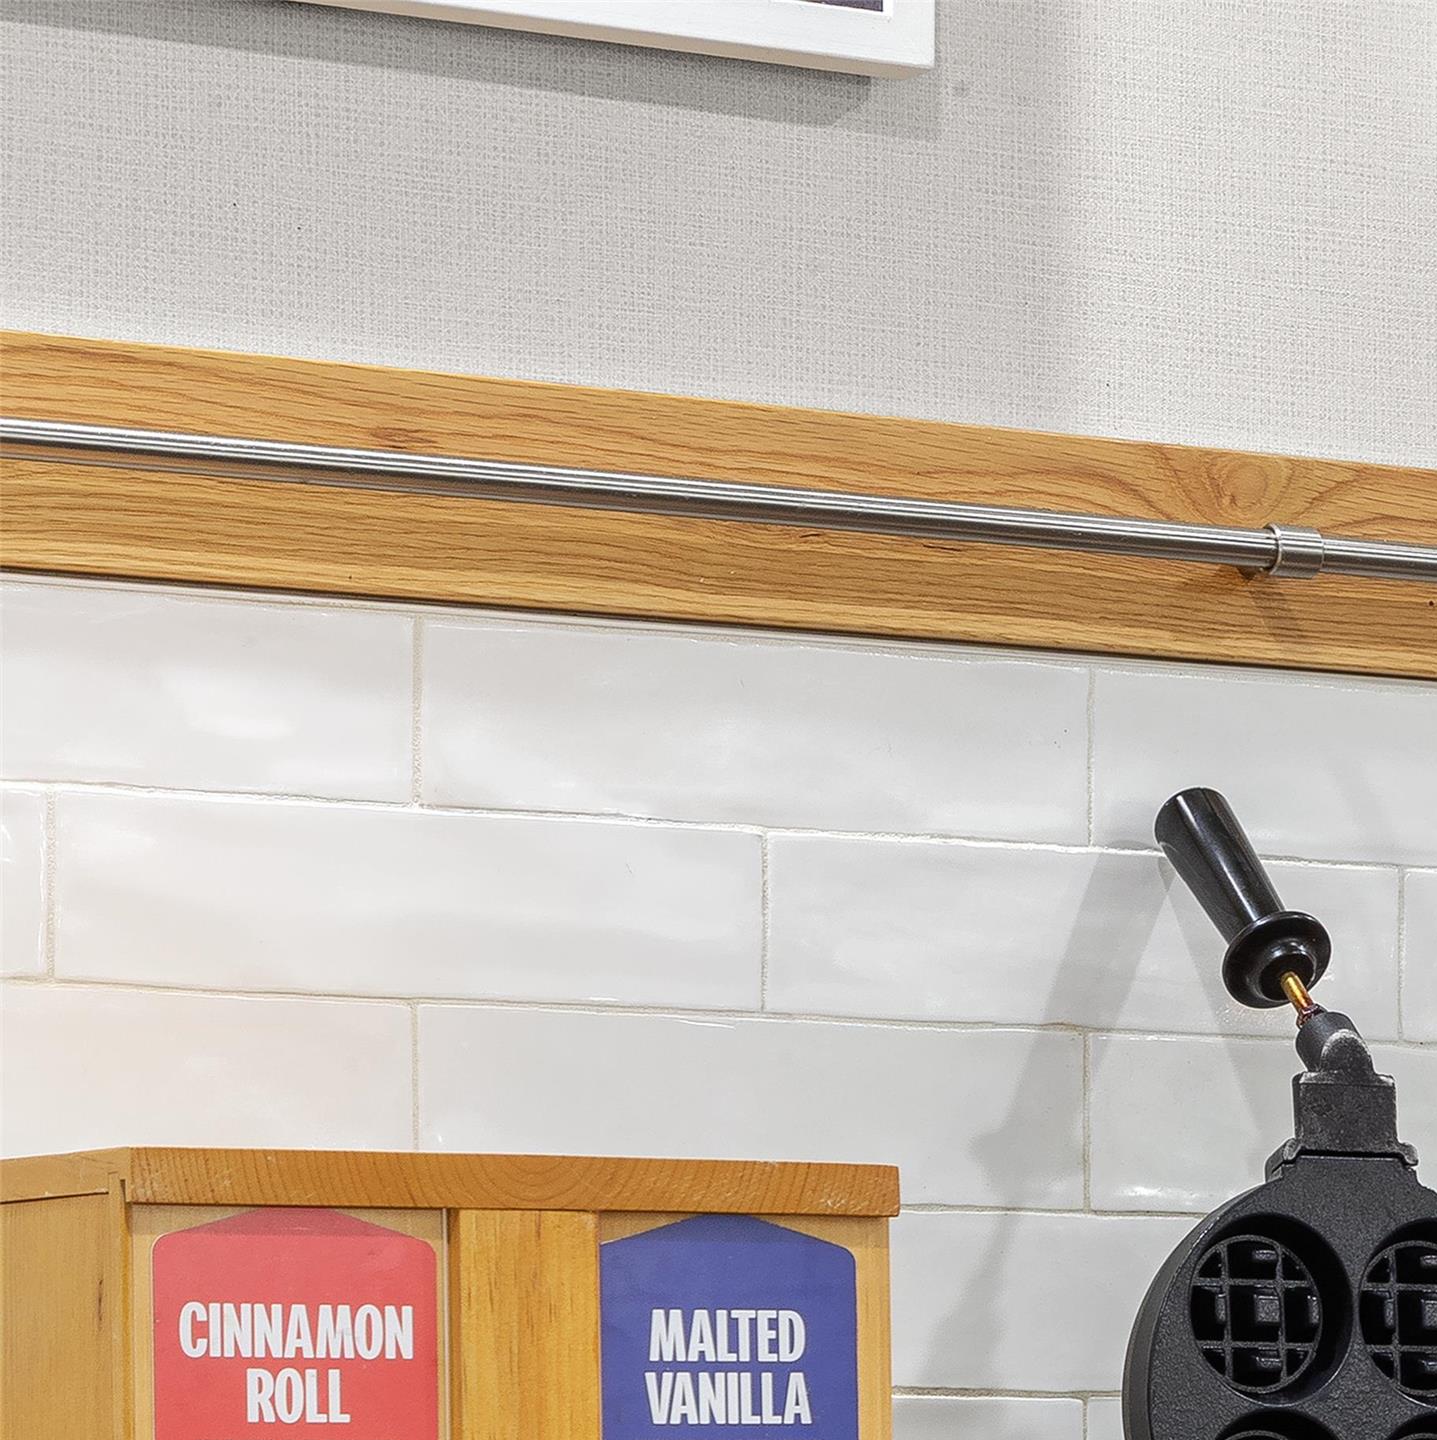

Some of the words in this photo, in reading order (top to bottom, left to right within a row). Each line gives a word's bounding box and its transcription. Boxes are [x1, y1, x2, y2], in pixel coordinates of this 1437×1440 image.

[178, 1300, 414, 1360] CINNAMON
[649, 1308, 805, 1363] MALTED
[246, 1367, 351, 1425] ROLL
[644, 1371, 812, 1425] VANILLA
